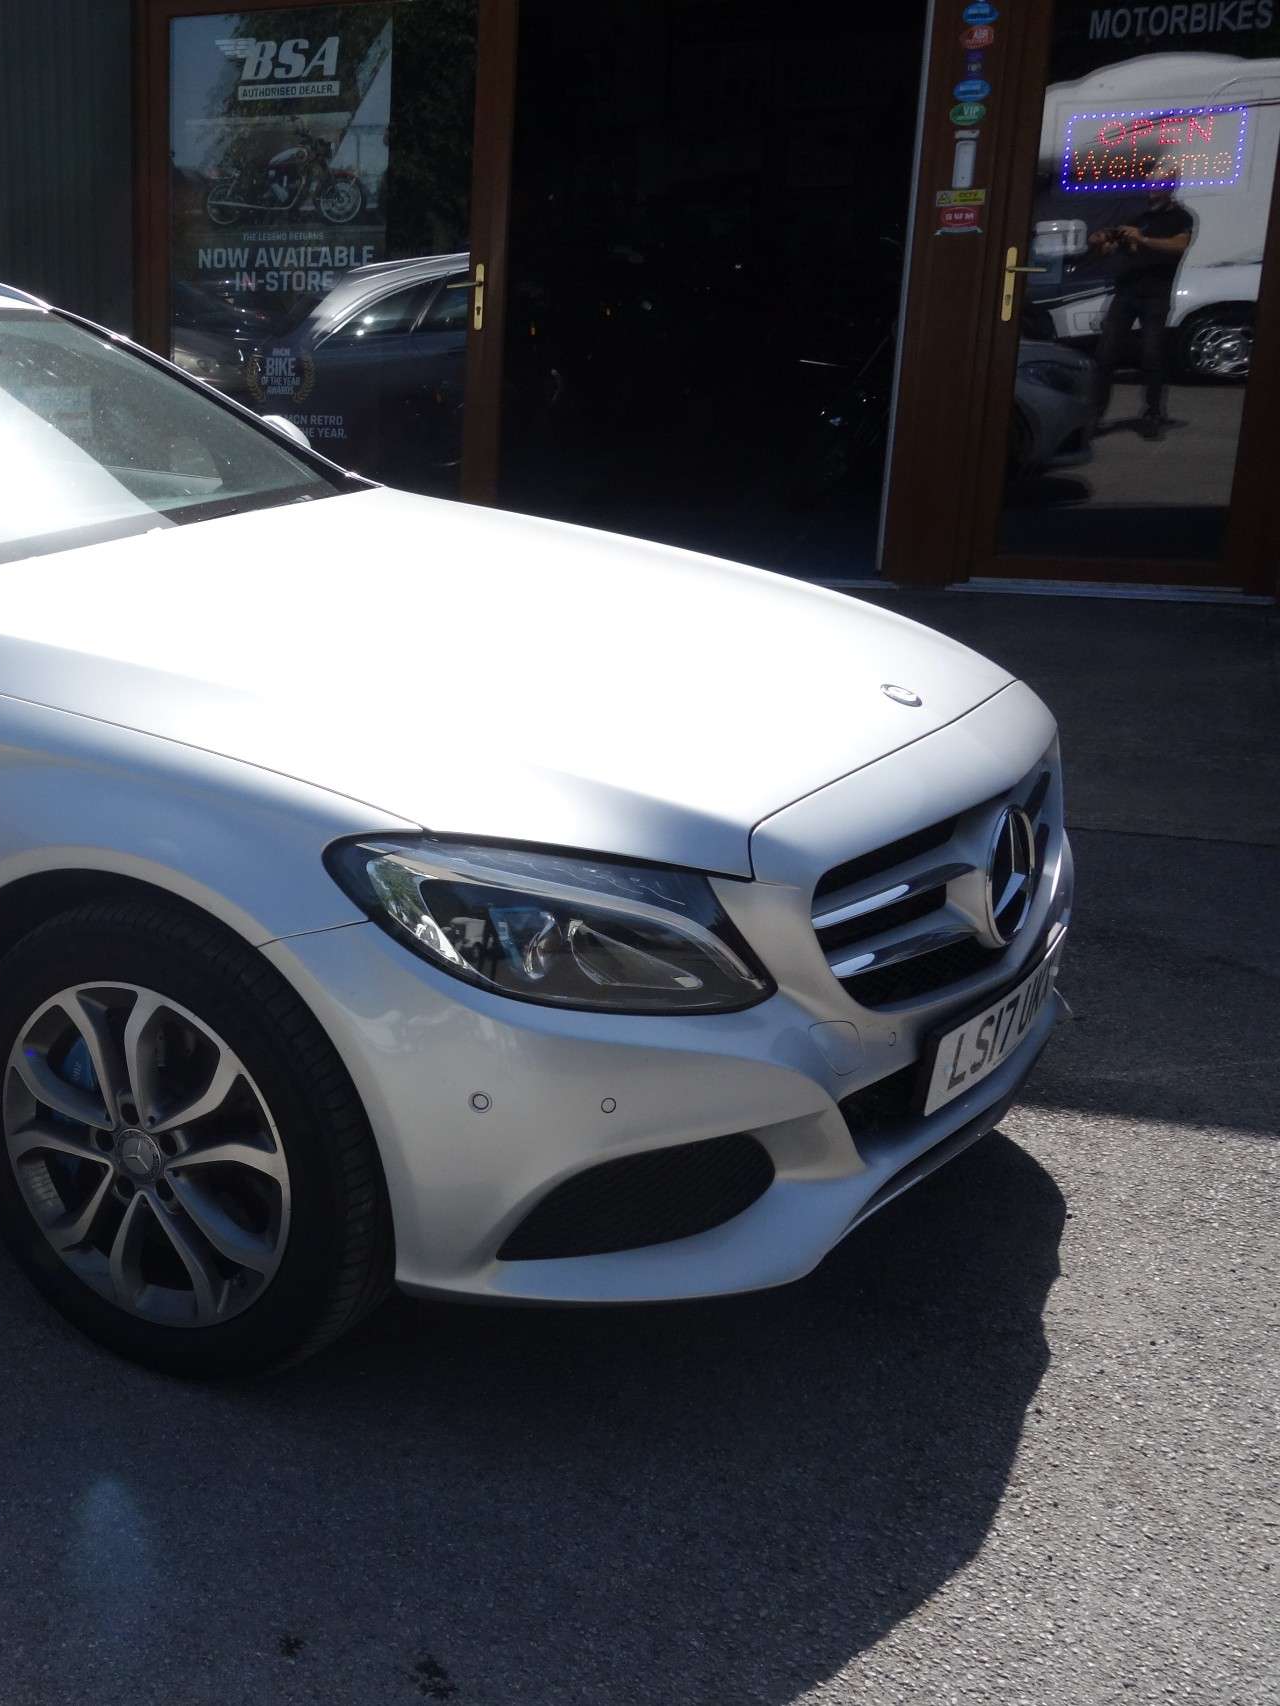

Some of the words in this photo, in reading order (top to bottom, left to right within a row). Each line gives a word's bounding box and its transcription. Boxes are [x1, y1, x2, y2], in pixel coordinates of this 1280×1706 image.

[1089, 2, 1273, 39] MOTORBIKES
[239, 36, 340, 80] BSA
[242, 85, 297, 98] AUTHORISED
[1097, 114, 1215, 147] OPEN
[1073, 149, 1232, 181] Welcome
[198, 248, 250, 269] NOW
[255, 246, 375, 267] AVAILABLE
[235, 271, 335, 292] IN-STORE
[265, 357, 296, 377] BIKE
[261, 376, 270, 386] OF
[310, 415, 343, 426] RETRO
